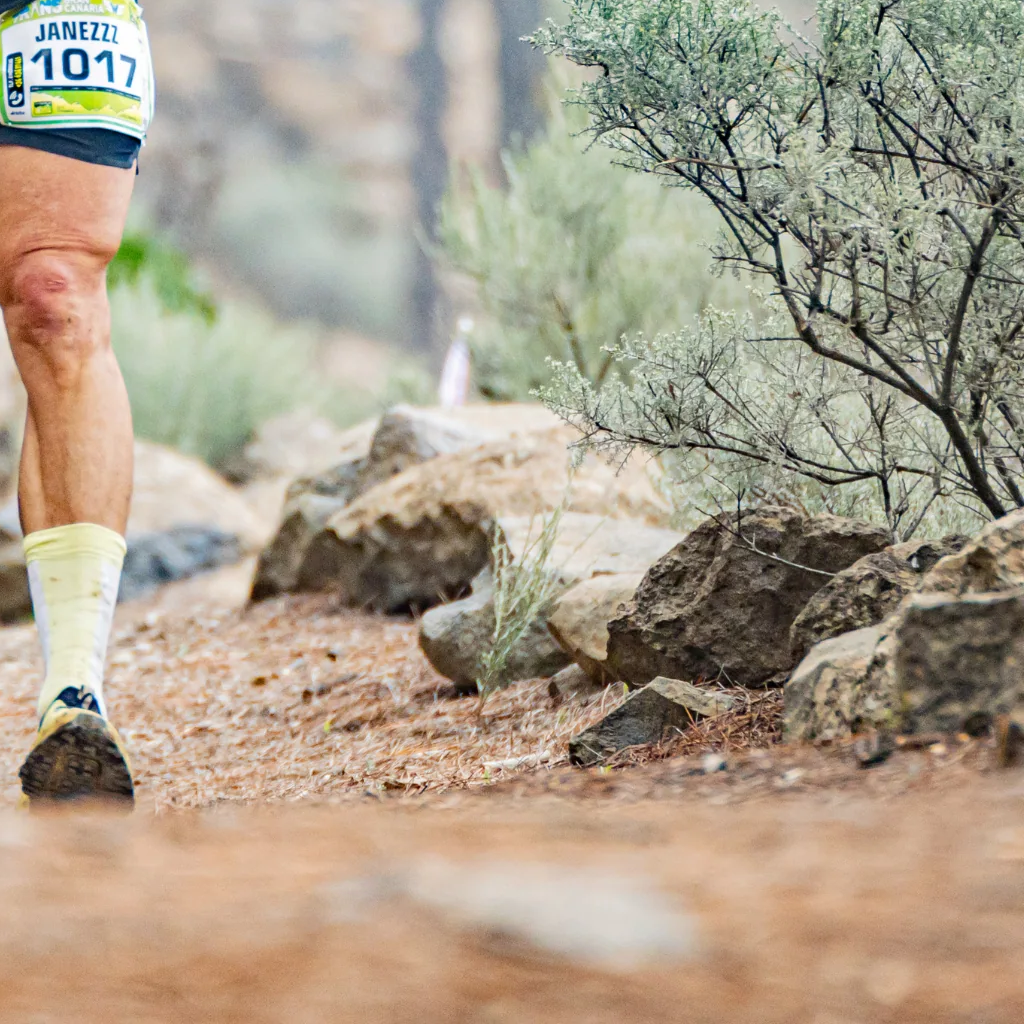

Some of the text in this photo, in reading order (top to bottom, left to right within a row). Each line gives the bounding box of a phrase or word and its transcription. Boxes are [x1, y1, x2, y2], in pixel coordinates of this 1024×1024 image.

[64, 4, 104, 14] CANARIA
[35, 21, 119, 44] JANEZZZ
[30, 48, 137, 88] 1017
